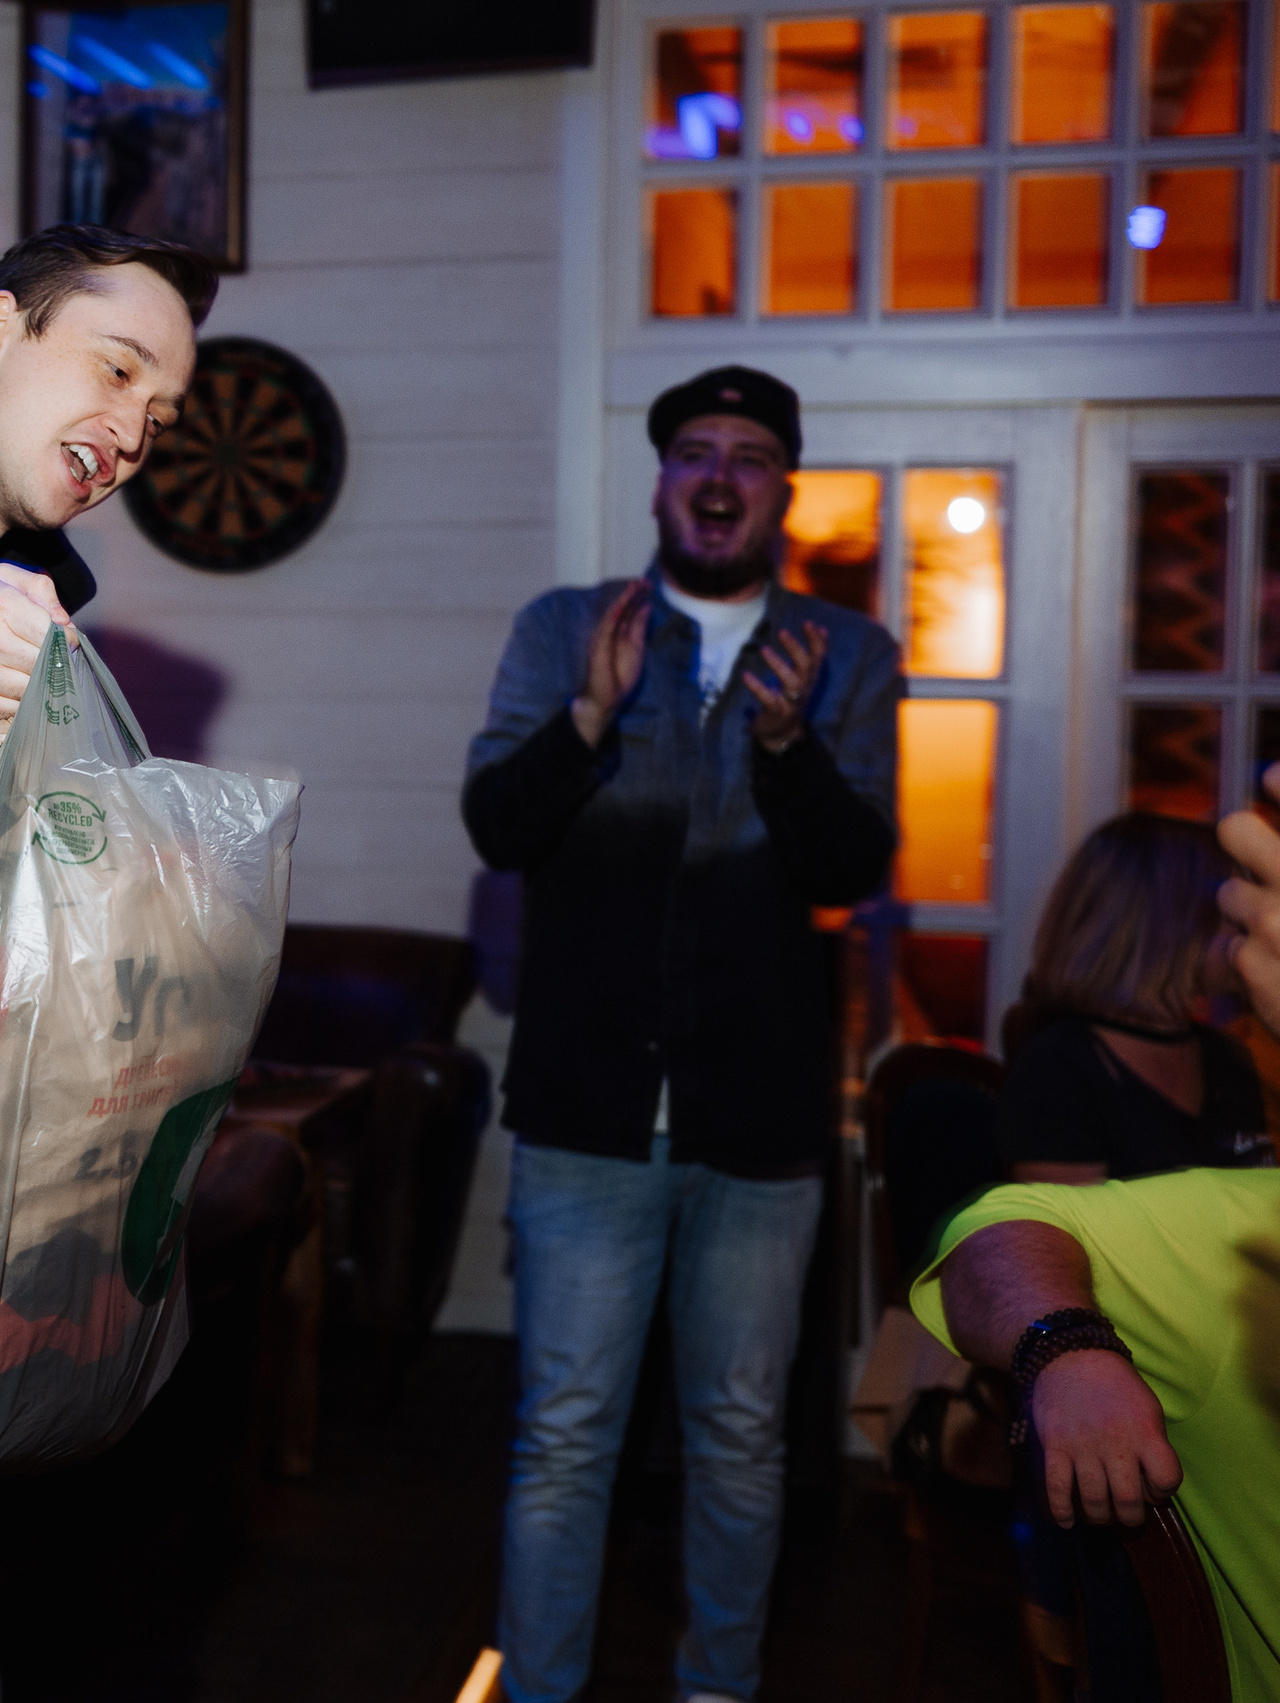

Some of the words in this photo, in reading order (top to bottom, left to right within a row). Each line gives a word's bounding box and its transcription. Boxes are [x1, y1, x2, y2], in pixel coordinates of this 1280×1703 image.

[60, 801, 82, 814] 35%
[48, 808, 93, 827] RECYCLED
[87, 1096, 130, 1119] ДЛЯ
